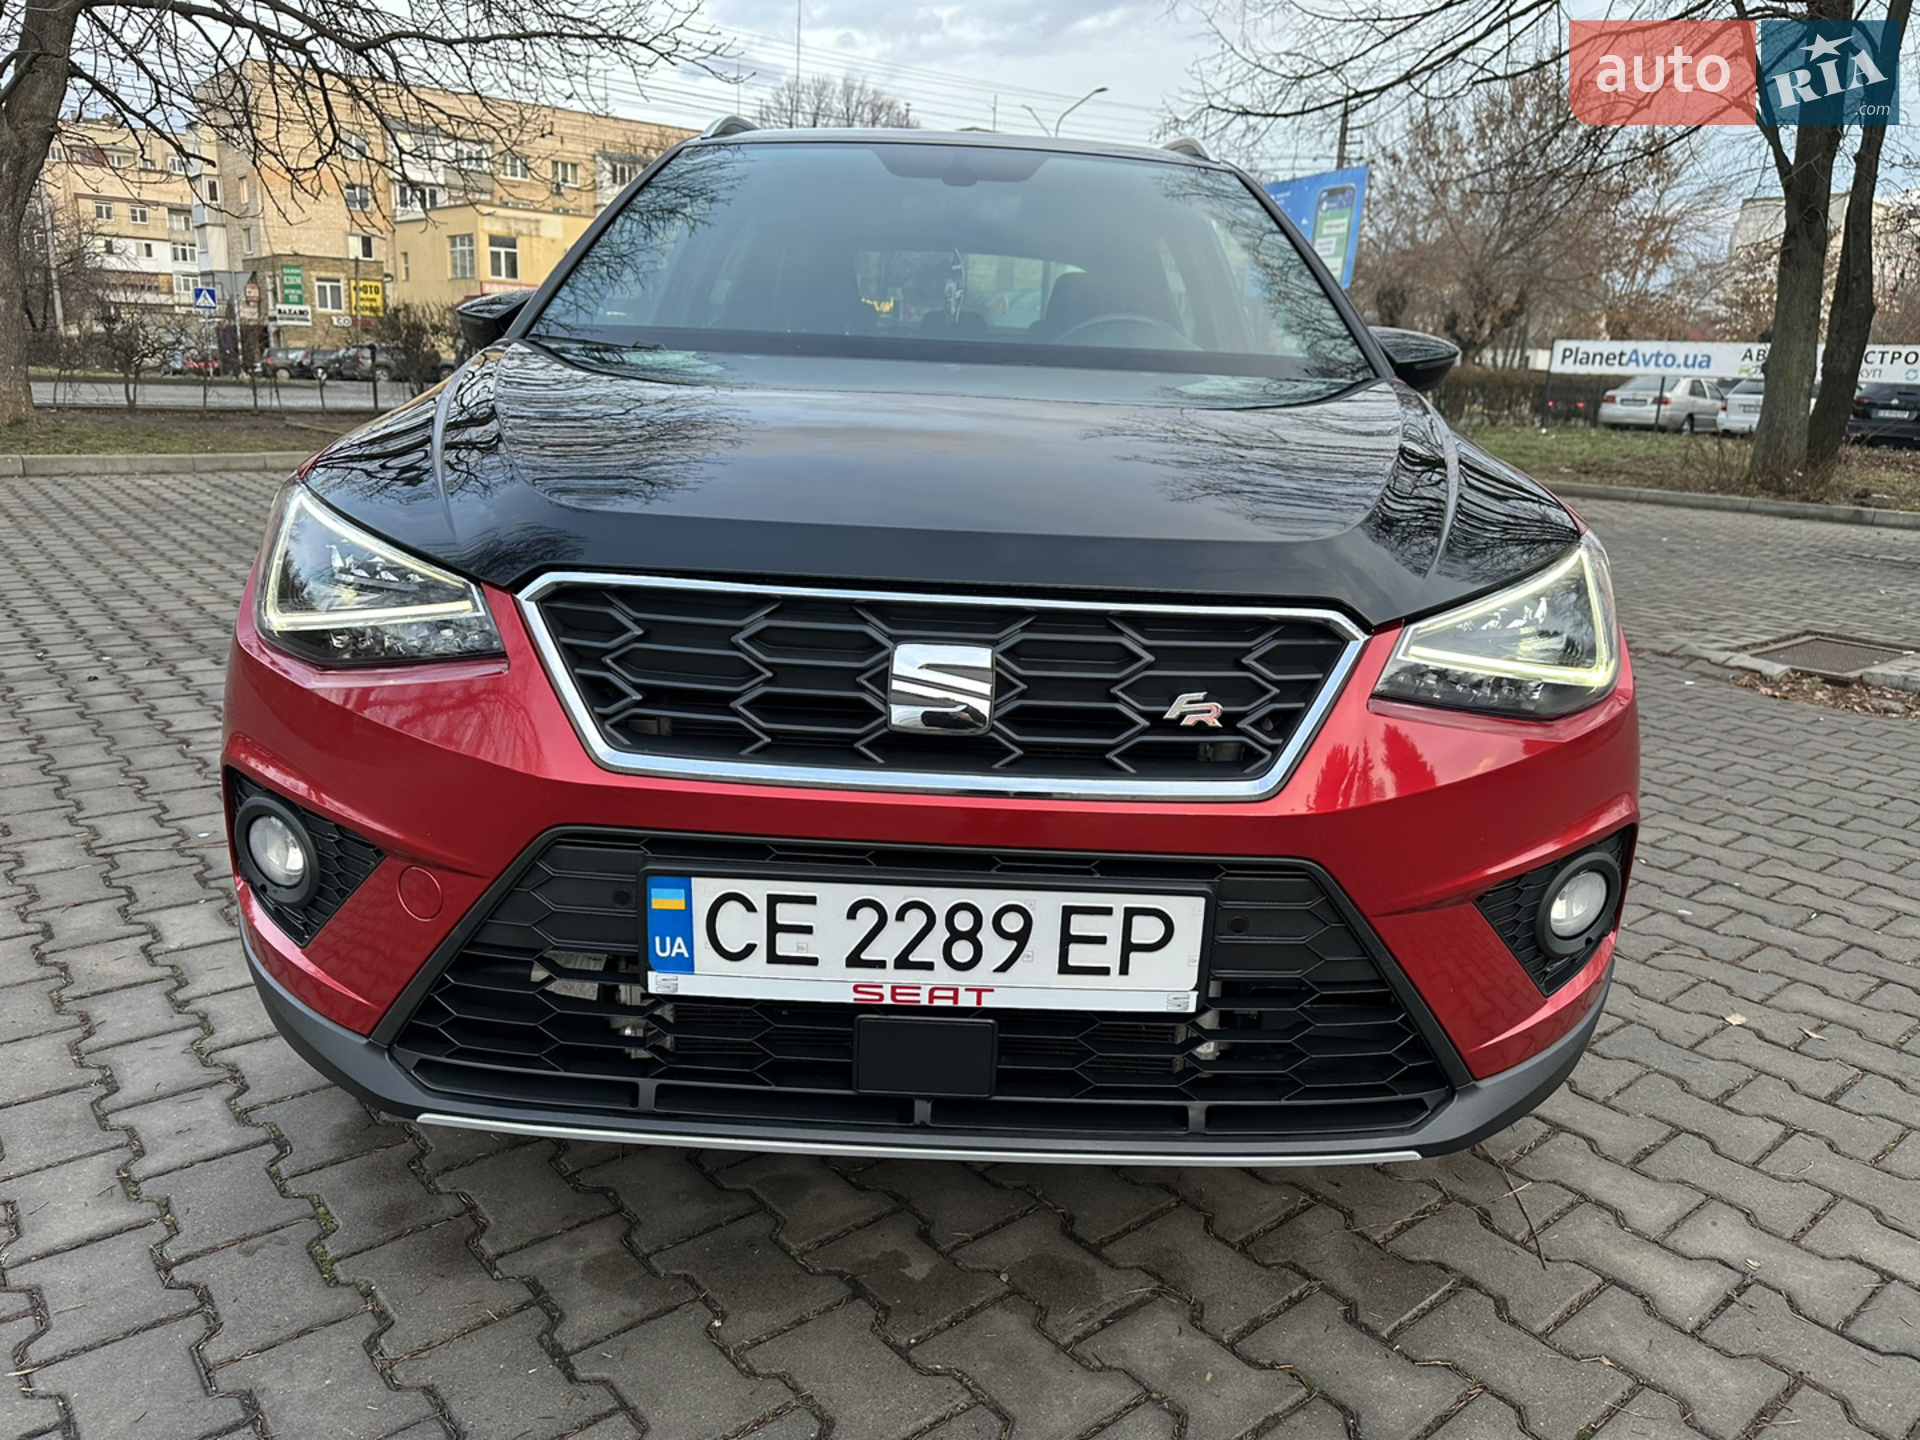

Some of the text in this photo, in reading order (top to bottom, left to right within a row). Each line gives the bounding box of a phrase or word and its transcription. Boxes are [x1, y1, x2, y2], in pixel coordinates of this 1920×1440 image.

[1560, 347, 1712, 370] PlanetAvto.ua
[1741, 348, 1919, 365] АВ СТРО
[1162, 691, 1224, 728] FR
[705, 891, 1175, 976] CE 2289 EP
[654, 935, 690, 959] UA
[852, 983, 996, 1007] SEAT
